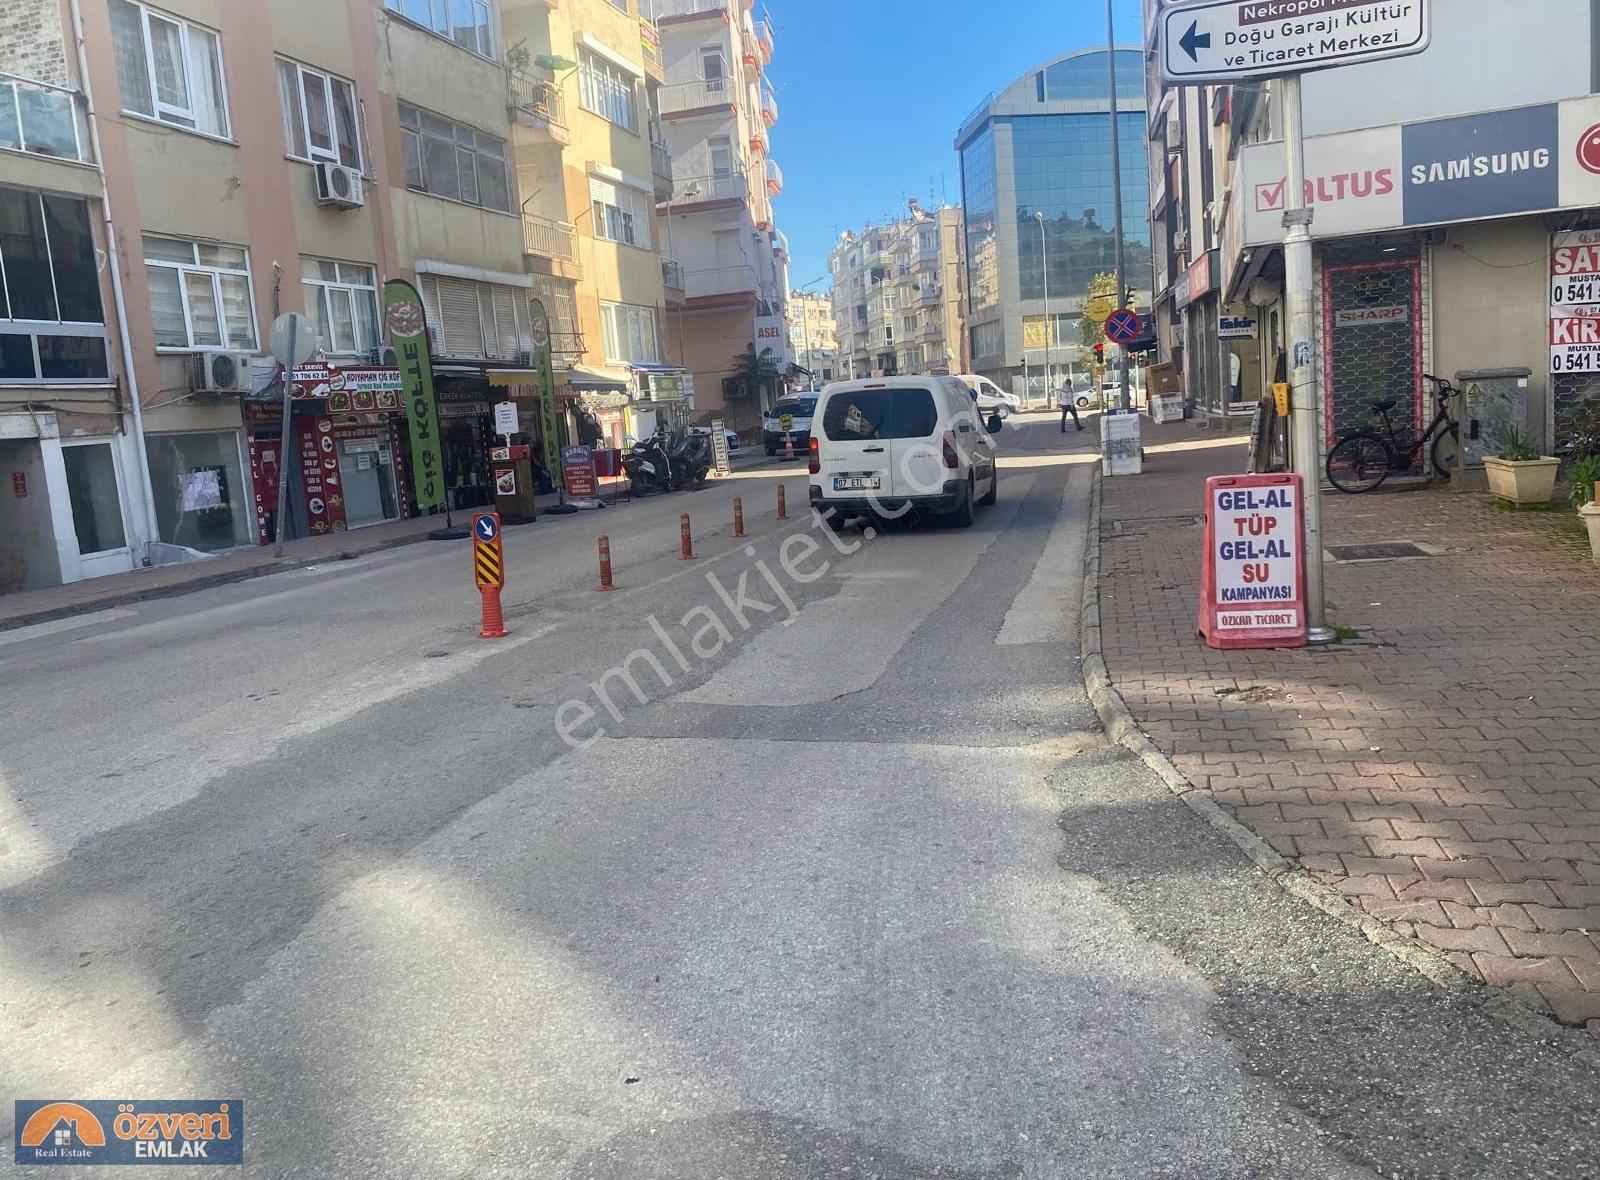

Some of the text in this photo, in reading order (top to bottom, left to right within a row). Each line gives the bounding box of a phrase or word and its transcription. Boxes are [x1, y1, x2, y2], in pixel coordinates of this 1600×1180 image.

[1224, 5, 1411, 46] Doğu Garajı Kültür
[1224, 29, 1399, 68] ve Ticaret Merkezi
[1410, 147, 1550, 186] SAMSUNG
[1554, 285, 1563, 302] 0
[1567, 283, 1593, 302] 541
[1220, 317, 1257, 329] Fakir
[1339, 308, 1404, 322] SHARP
[758, 327, 781, 339] ASEL
[1552, 354, 1561, 371] 0
[1566, 352, 1591, 371] 541
[320, 371, 328, 379] 84
[838, 479, 847, 487] 07
[851, 477, 865, 487] ETL
[1218, 489, 1292, 511] GEL-AL
[256, 494, 267, 537] COME
[1234, 513, 1277, 536] TÜP
[1219, 539, 1291, 560] GEL-AL
[1242, 563, 1269, 583] SU
[1221, 586, 1292, 602] KAMPANYASI
